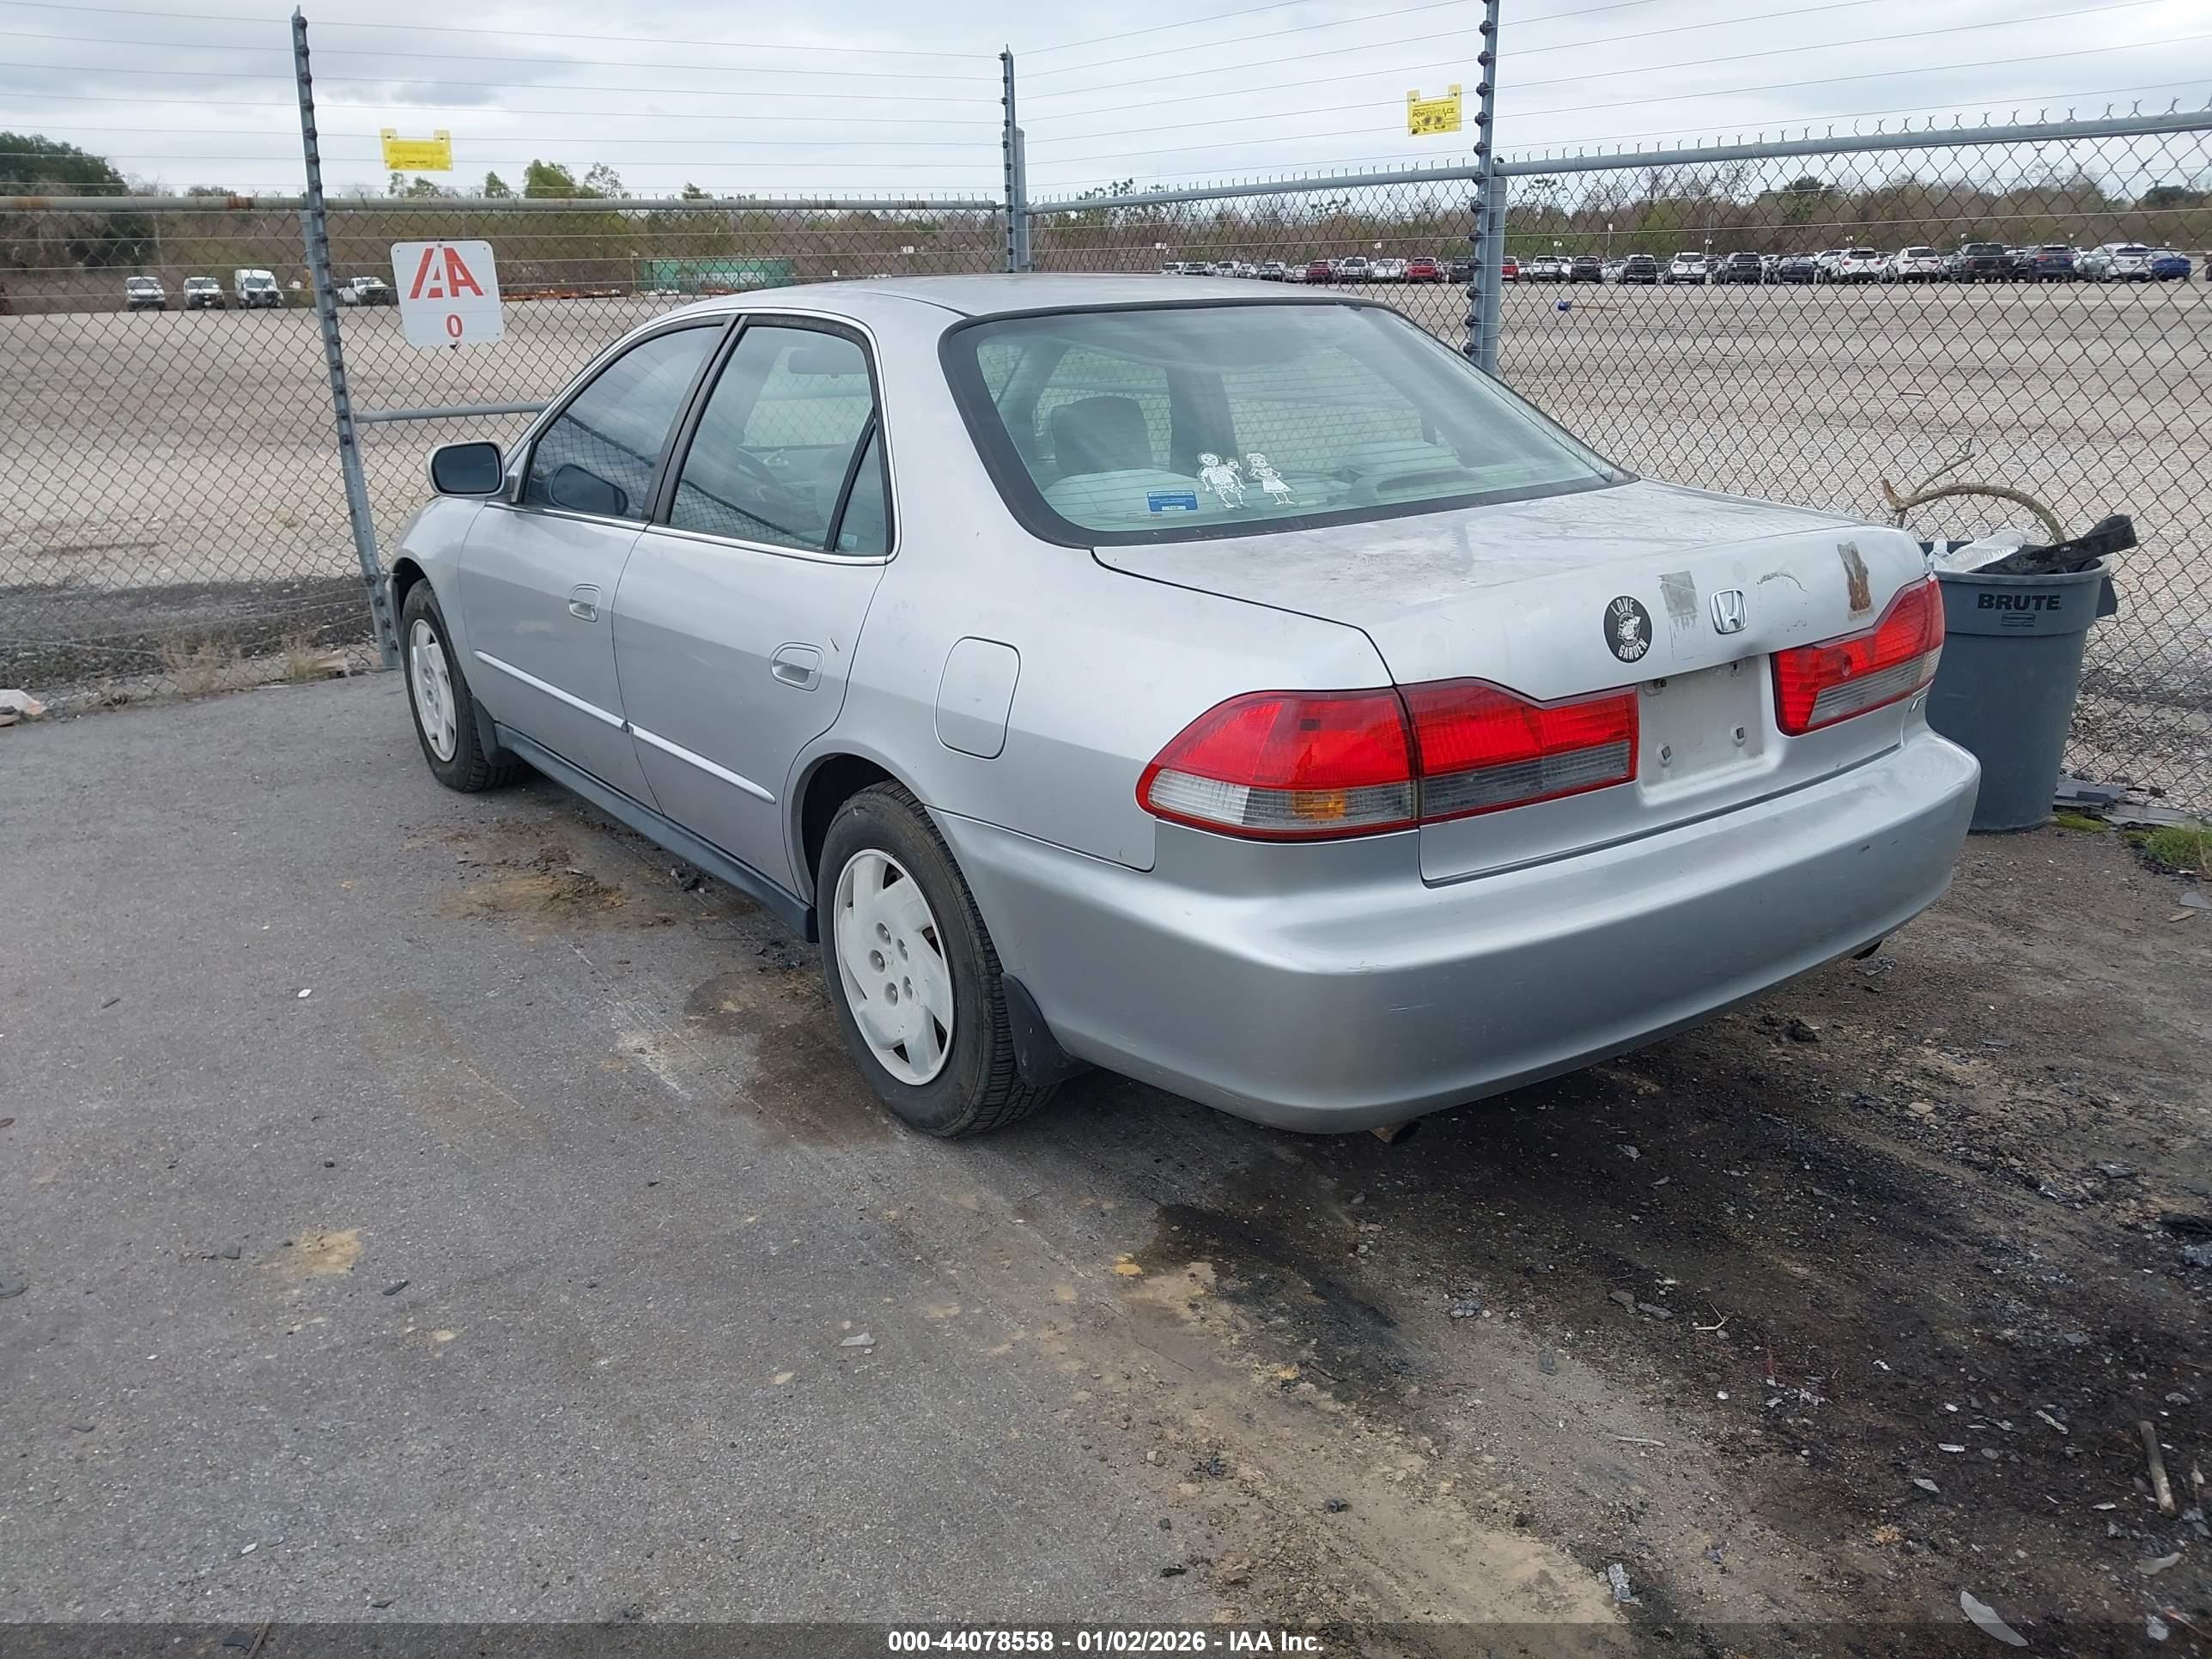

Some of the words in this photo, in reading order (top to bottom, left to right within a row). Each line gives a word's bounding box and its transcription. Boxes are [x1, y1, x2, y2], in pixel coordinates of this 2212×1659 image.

[1610, 597, 1635, 617] LOVE
[1978, 593, 2061, 611] BRUTE
[1618, 637, 1649, 660] GARDEN
